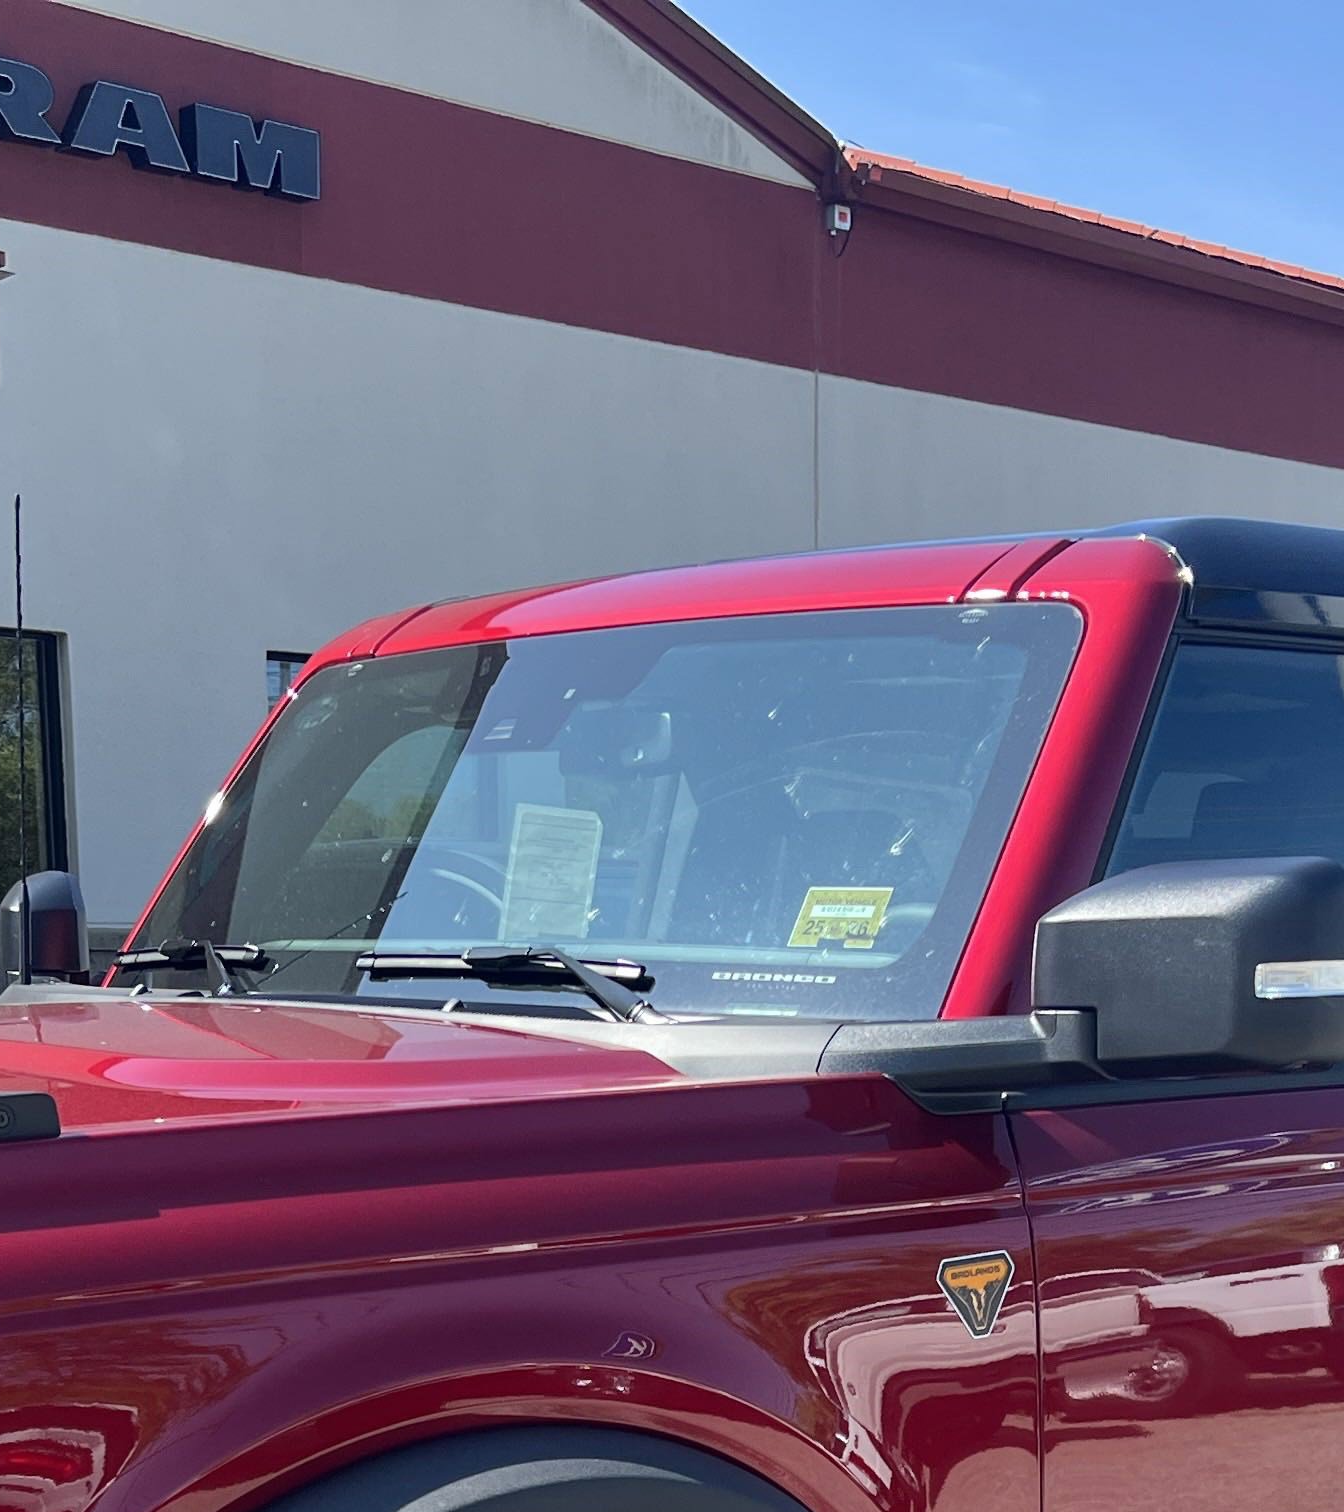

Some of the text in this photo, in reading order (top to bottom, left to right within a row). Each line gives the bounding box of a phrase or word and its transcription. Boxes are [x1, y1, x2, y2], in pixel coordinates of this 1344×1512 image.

[802, 919, 826, 936] 25
[712, 972, 837, 983] BRONCO
[951, 1265, 1000, 1279] BADLANDS
